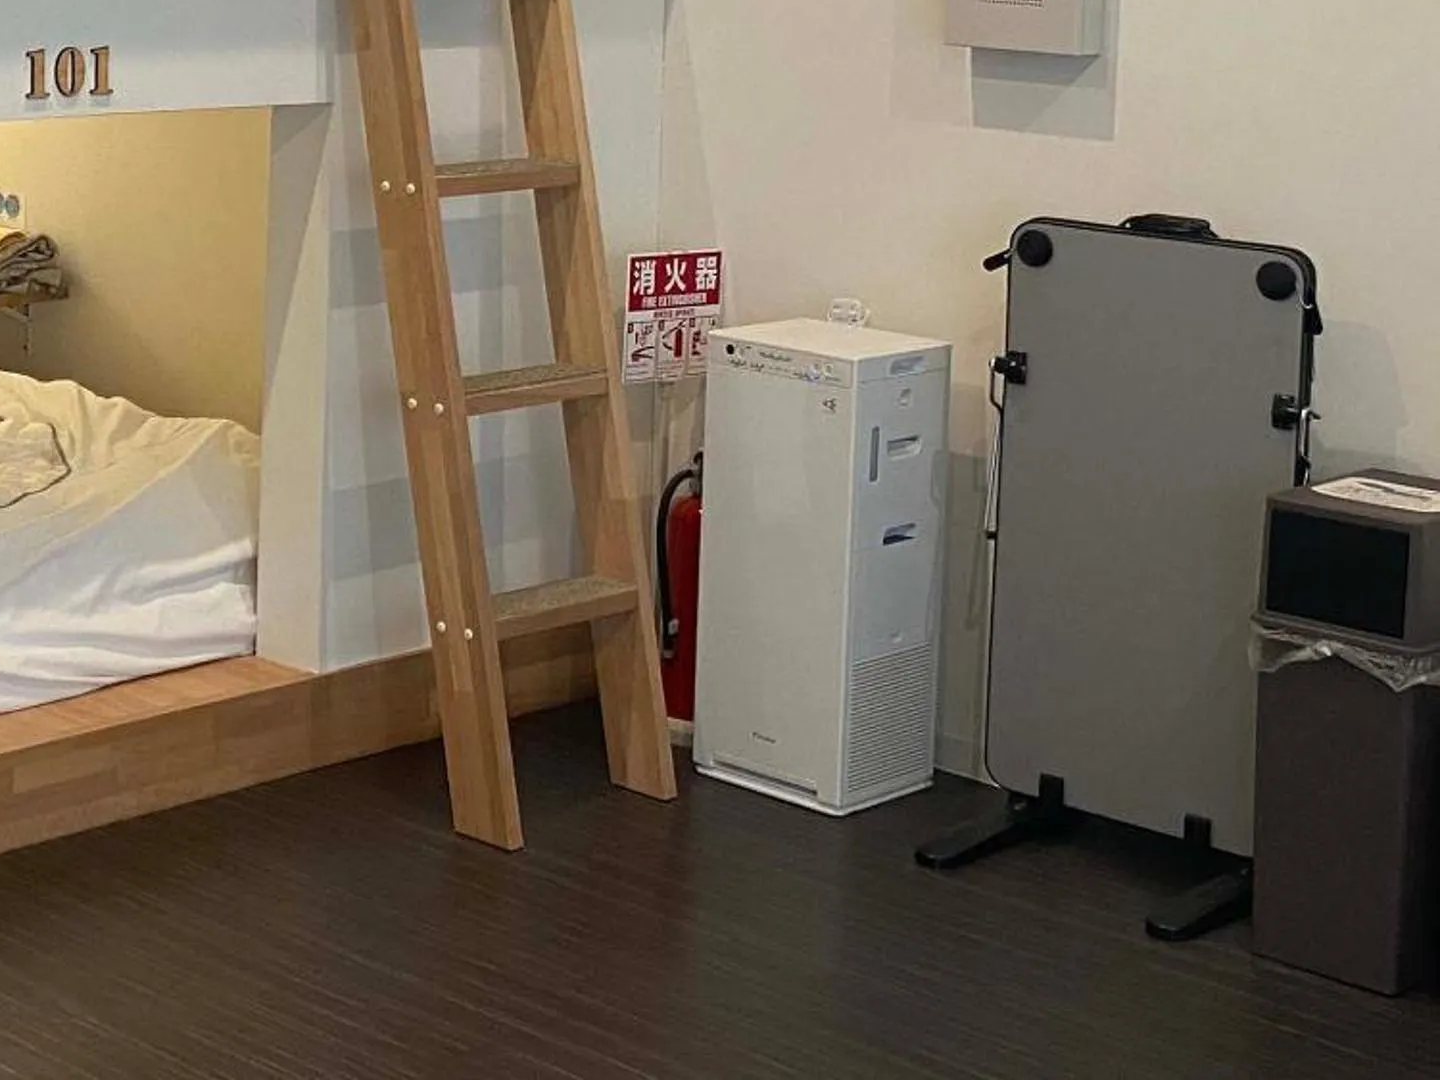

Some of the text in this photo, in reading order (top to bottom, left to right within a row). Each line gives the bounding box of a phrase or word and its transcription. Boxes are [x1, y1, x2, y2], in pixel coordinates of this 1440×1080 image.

[25, 45, 114, 100] 101
[633, 256, 717, 295] 消火器
